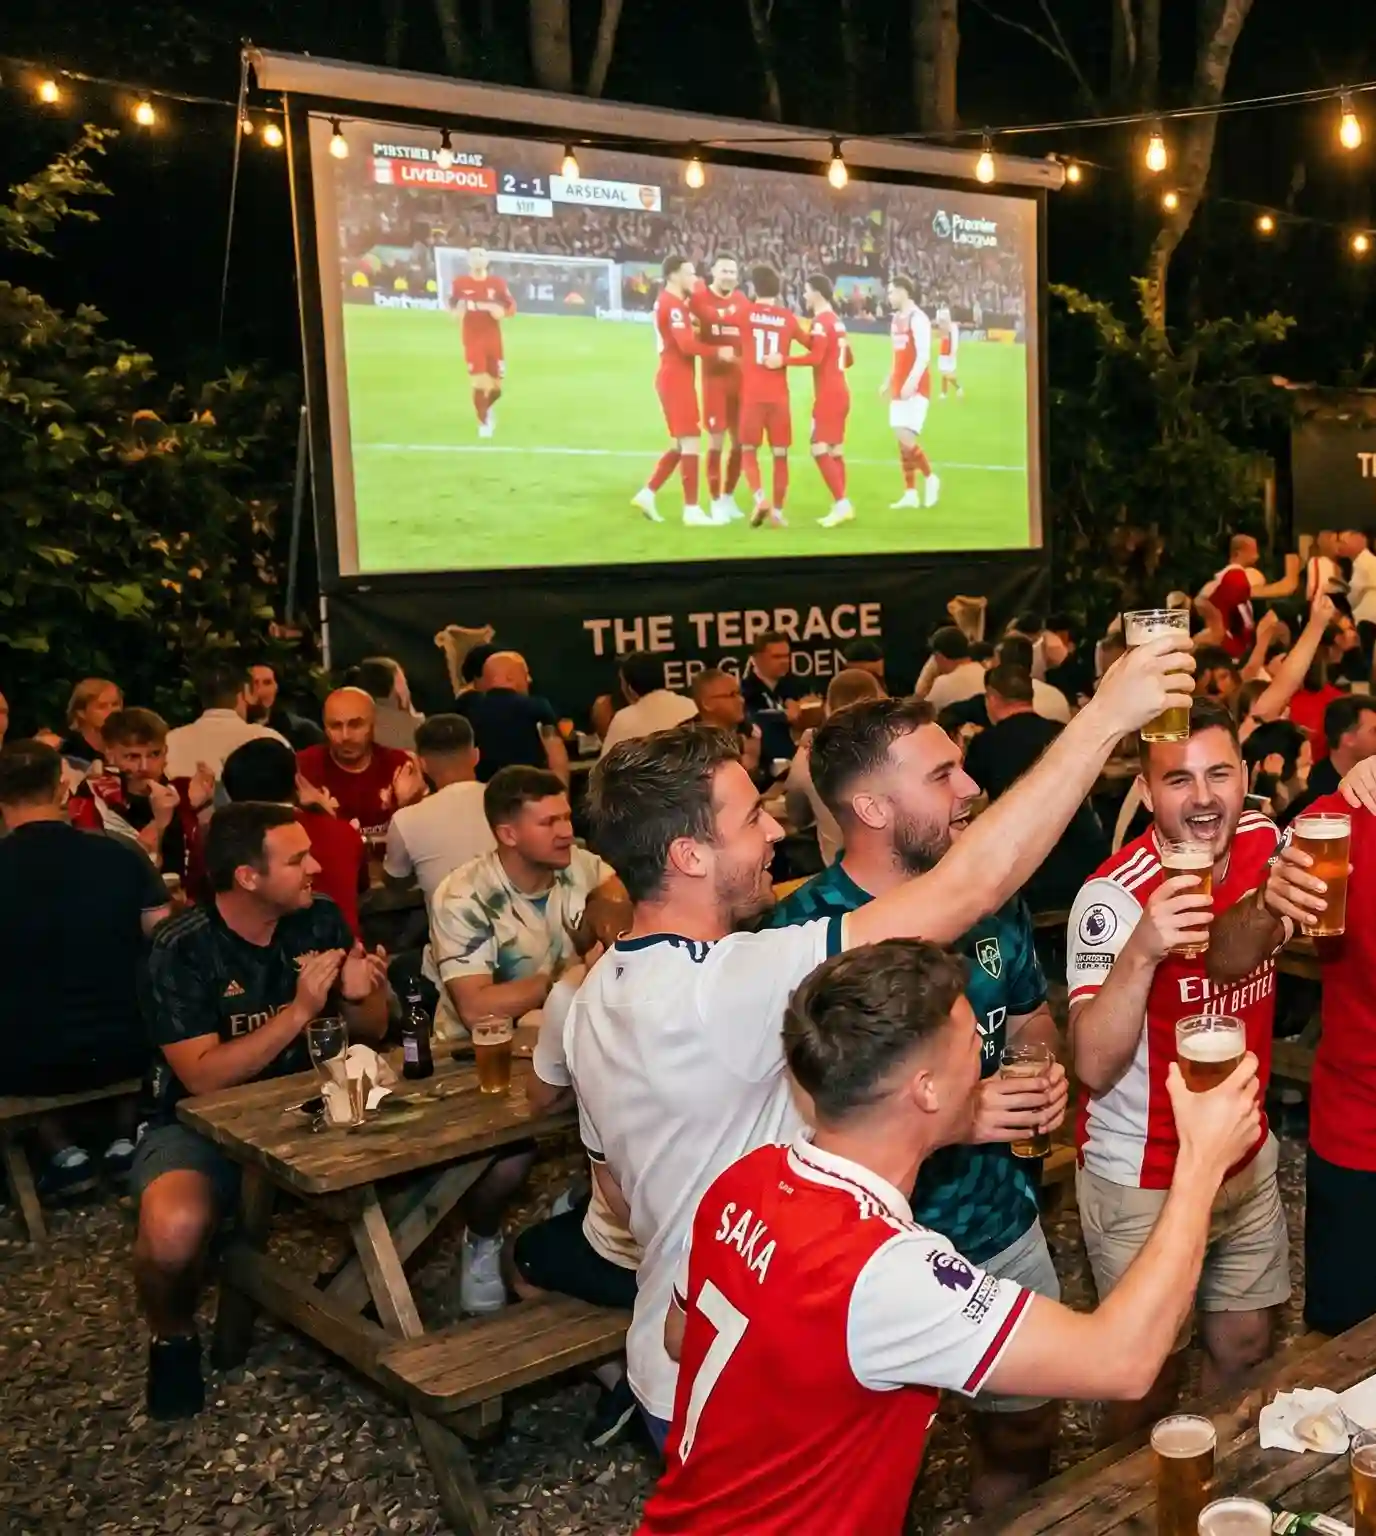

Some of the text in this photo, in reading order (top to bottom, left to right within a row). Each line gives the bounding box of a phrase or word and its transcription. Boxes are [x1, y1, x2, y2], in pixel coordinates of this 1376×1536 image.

[401, 165, 488, 188] LIVERPOOL
[503, 174, 516, 193] 2
[532, 178, 545, 195] 1
[565, 184, 628, 202] ARSENAL
[583, 602, 882, 655] THE TERRACE
[715, 1202, 777, 1284] SAKA
[678, 1278, 750, 1466] 7
